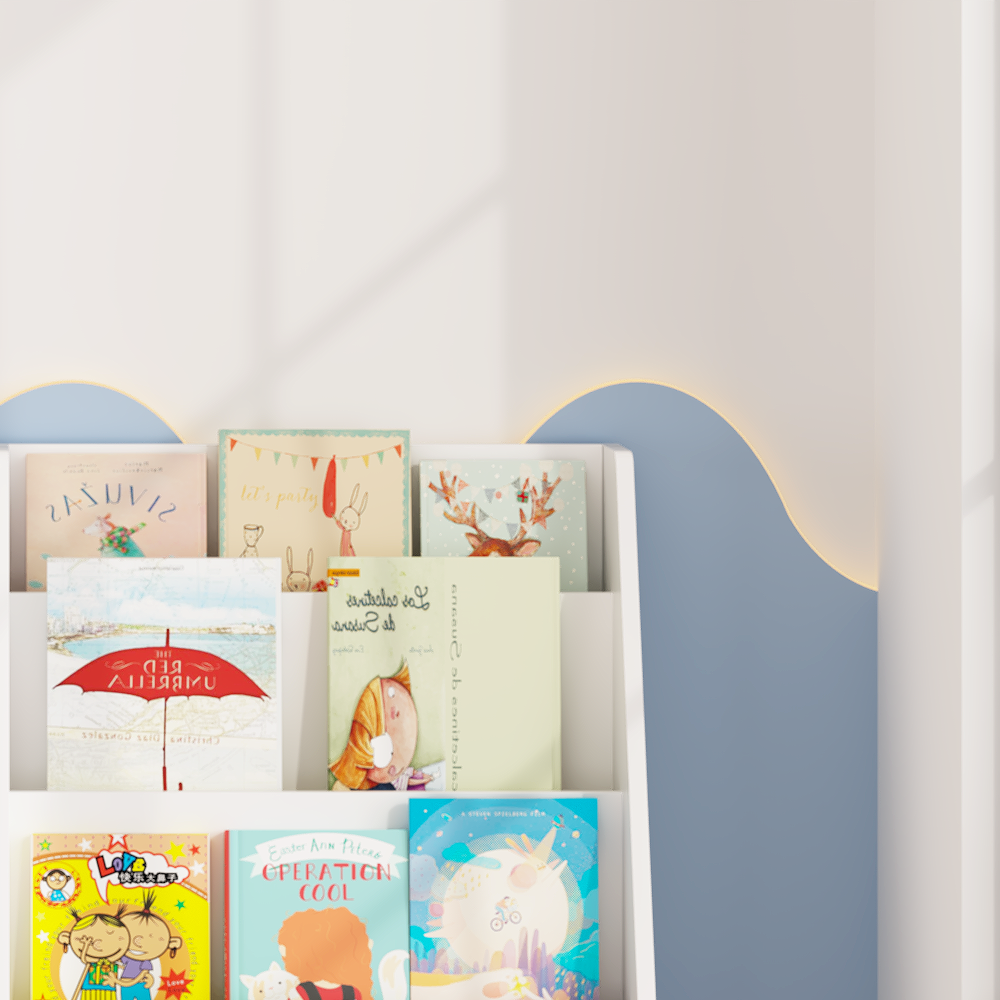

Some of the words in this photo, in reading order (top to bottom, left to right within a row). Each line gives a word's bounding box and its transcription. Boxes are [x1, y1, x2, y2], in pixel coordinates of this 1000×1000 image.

[275, 486, 319, 514] party
[262, 863, 391, 881] OPERATION
[299, 883, 354, 902] COOL
